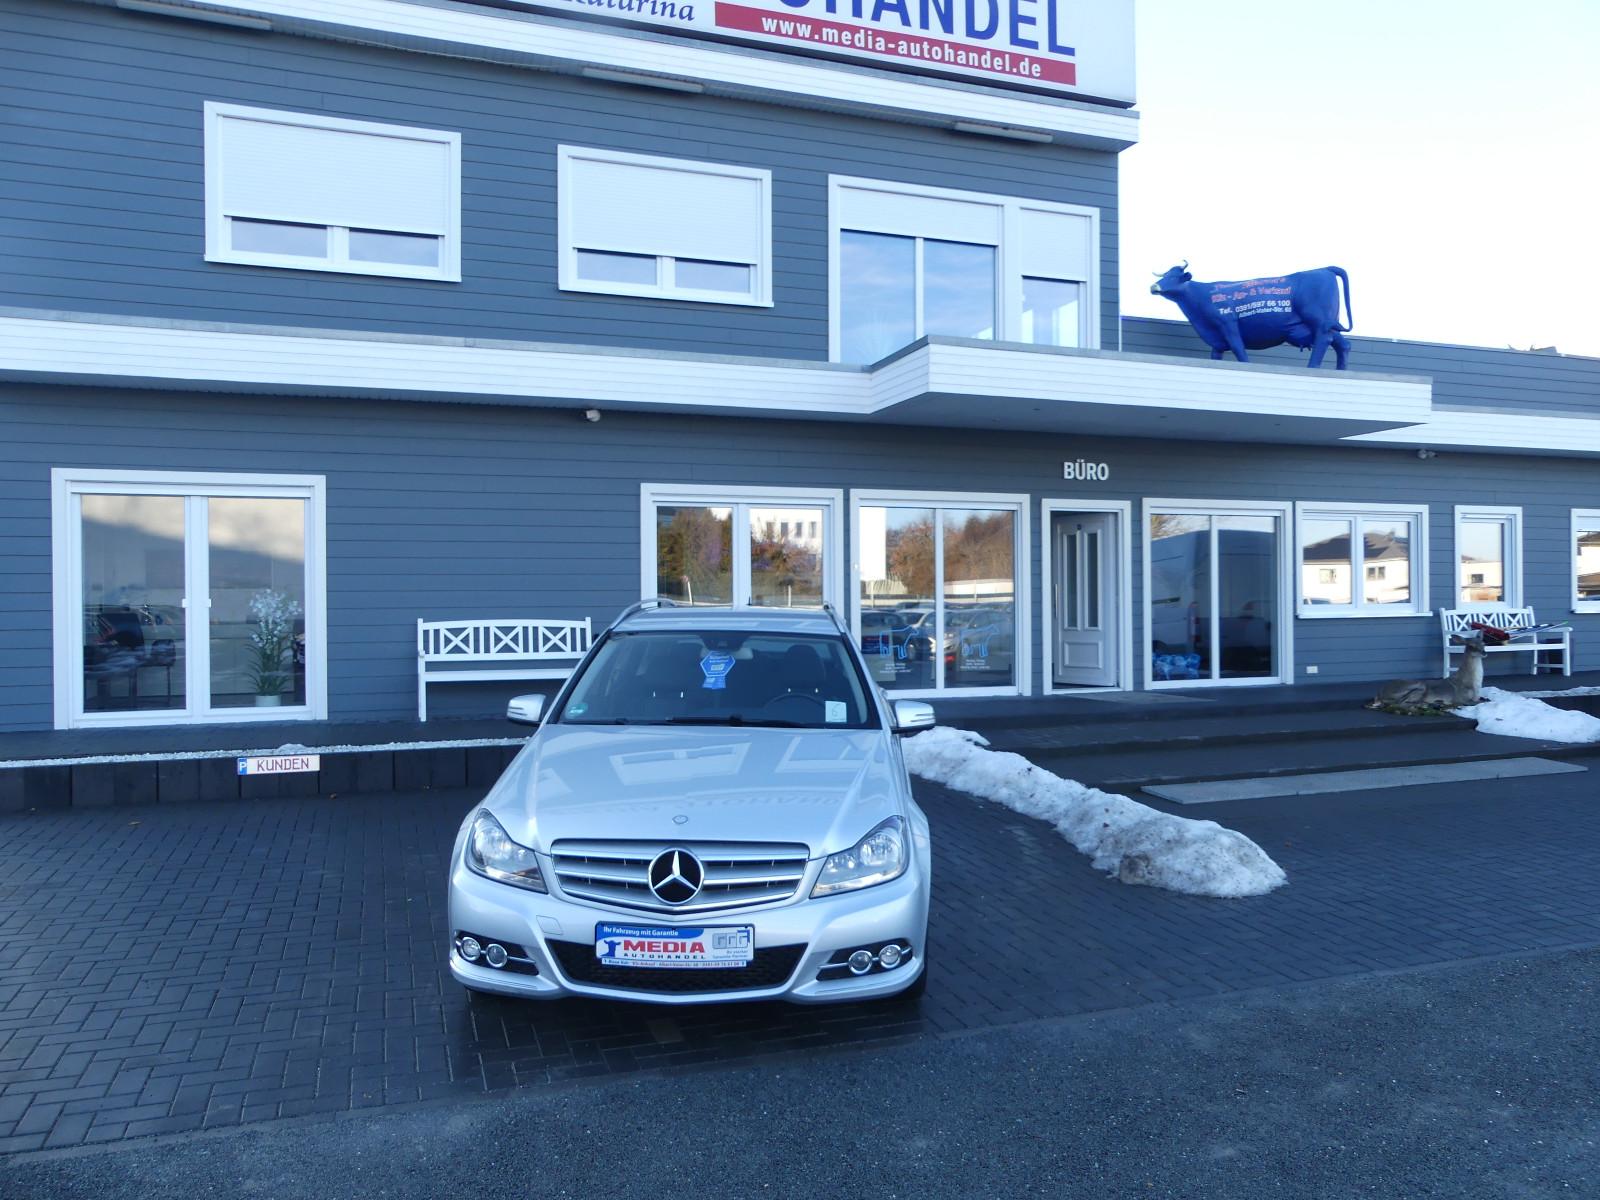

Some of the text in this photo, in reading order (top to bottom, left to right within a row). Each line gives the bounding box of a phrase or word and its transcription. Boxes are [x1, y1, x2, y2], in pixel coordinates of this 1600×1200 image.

[565, 0, 695, 21] arina
[779, 0, 1075, 57] NDEL
[760, 15, 1042, 79] www.media-autohandel.de
[1219, 307, 1233, 316] Tel.
[1277, 299, 1291, 307] 100
[1063, 459, 1109, 481] BÜRO
[239, 757, 309, 772] P KUNDEN
[612, 927, 640, 937] Fahrzeug
[640, 928, 652, 936] mit
[652, 929, 679, 937] Garantie
[623, 939, 706, 954] MEDIA
